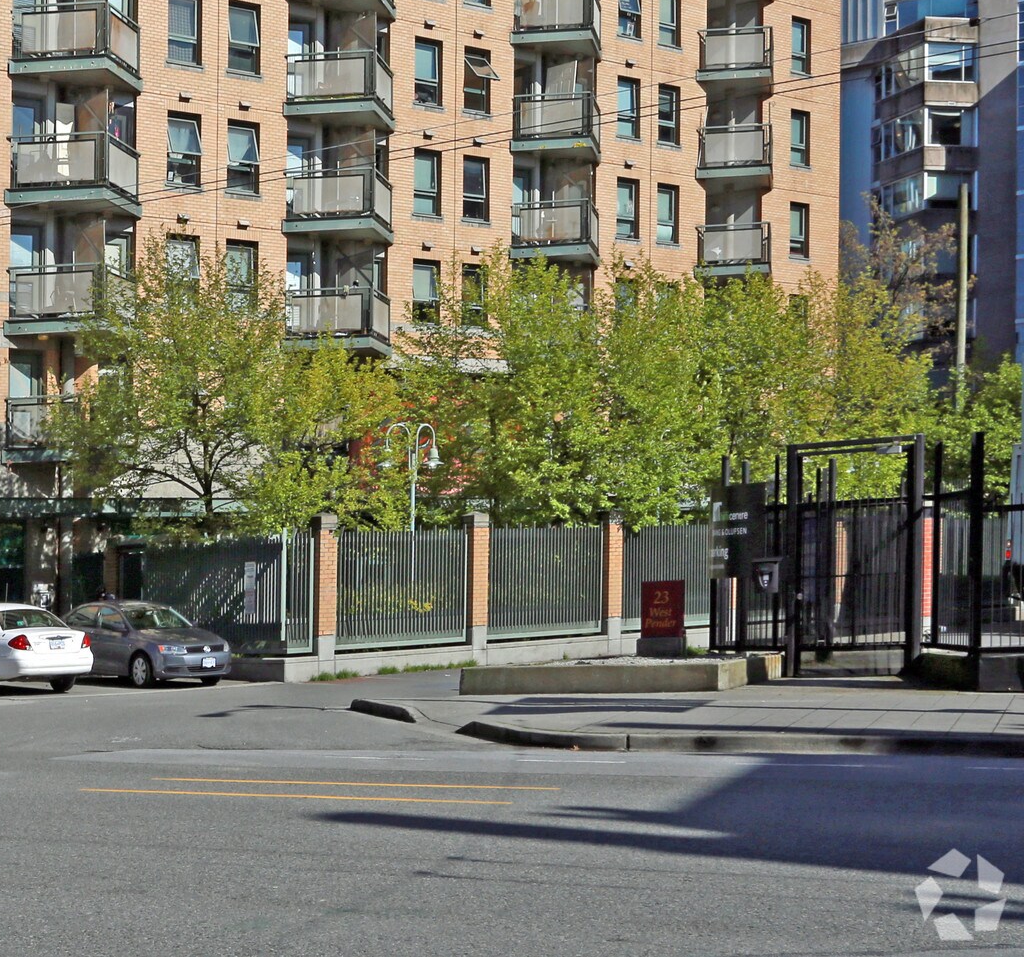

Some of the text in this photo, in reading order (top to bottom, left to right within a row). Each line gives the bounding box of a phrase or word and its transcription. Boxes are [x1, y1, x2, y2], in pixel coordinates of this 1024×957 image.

[653, 590, 670, 604] 23
[649, 607, 672, 617] West
[645, 617, 677, 629] Pender
